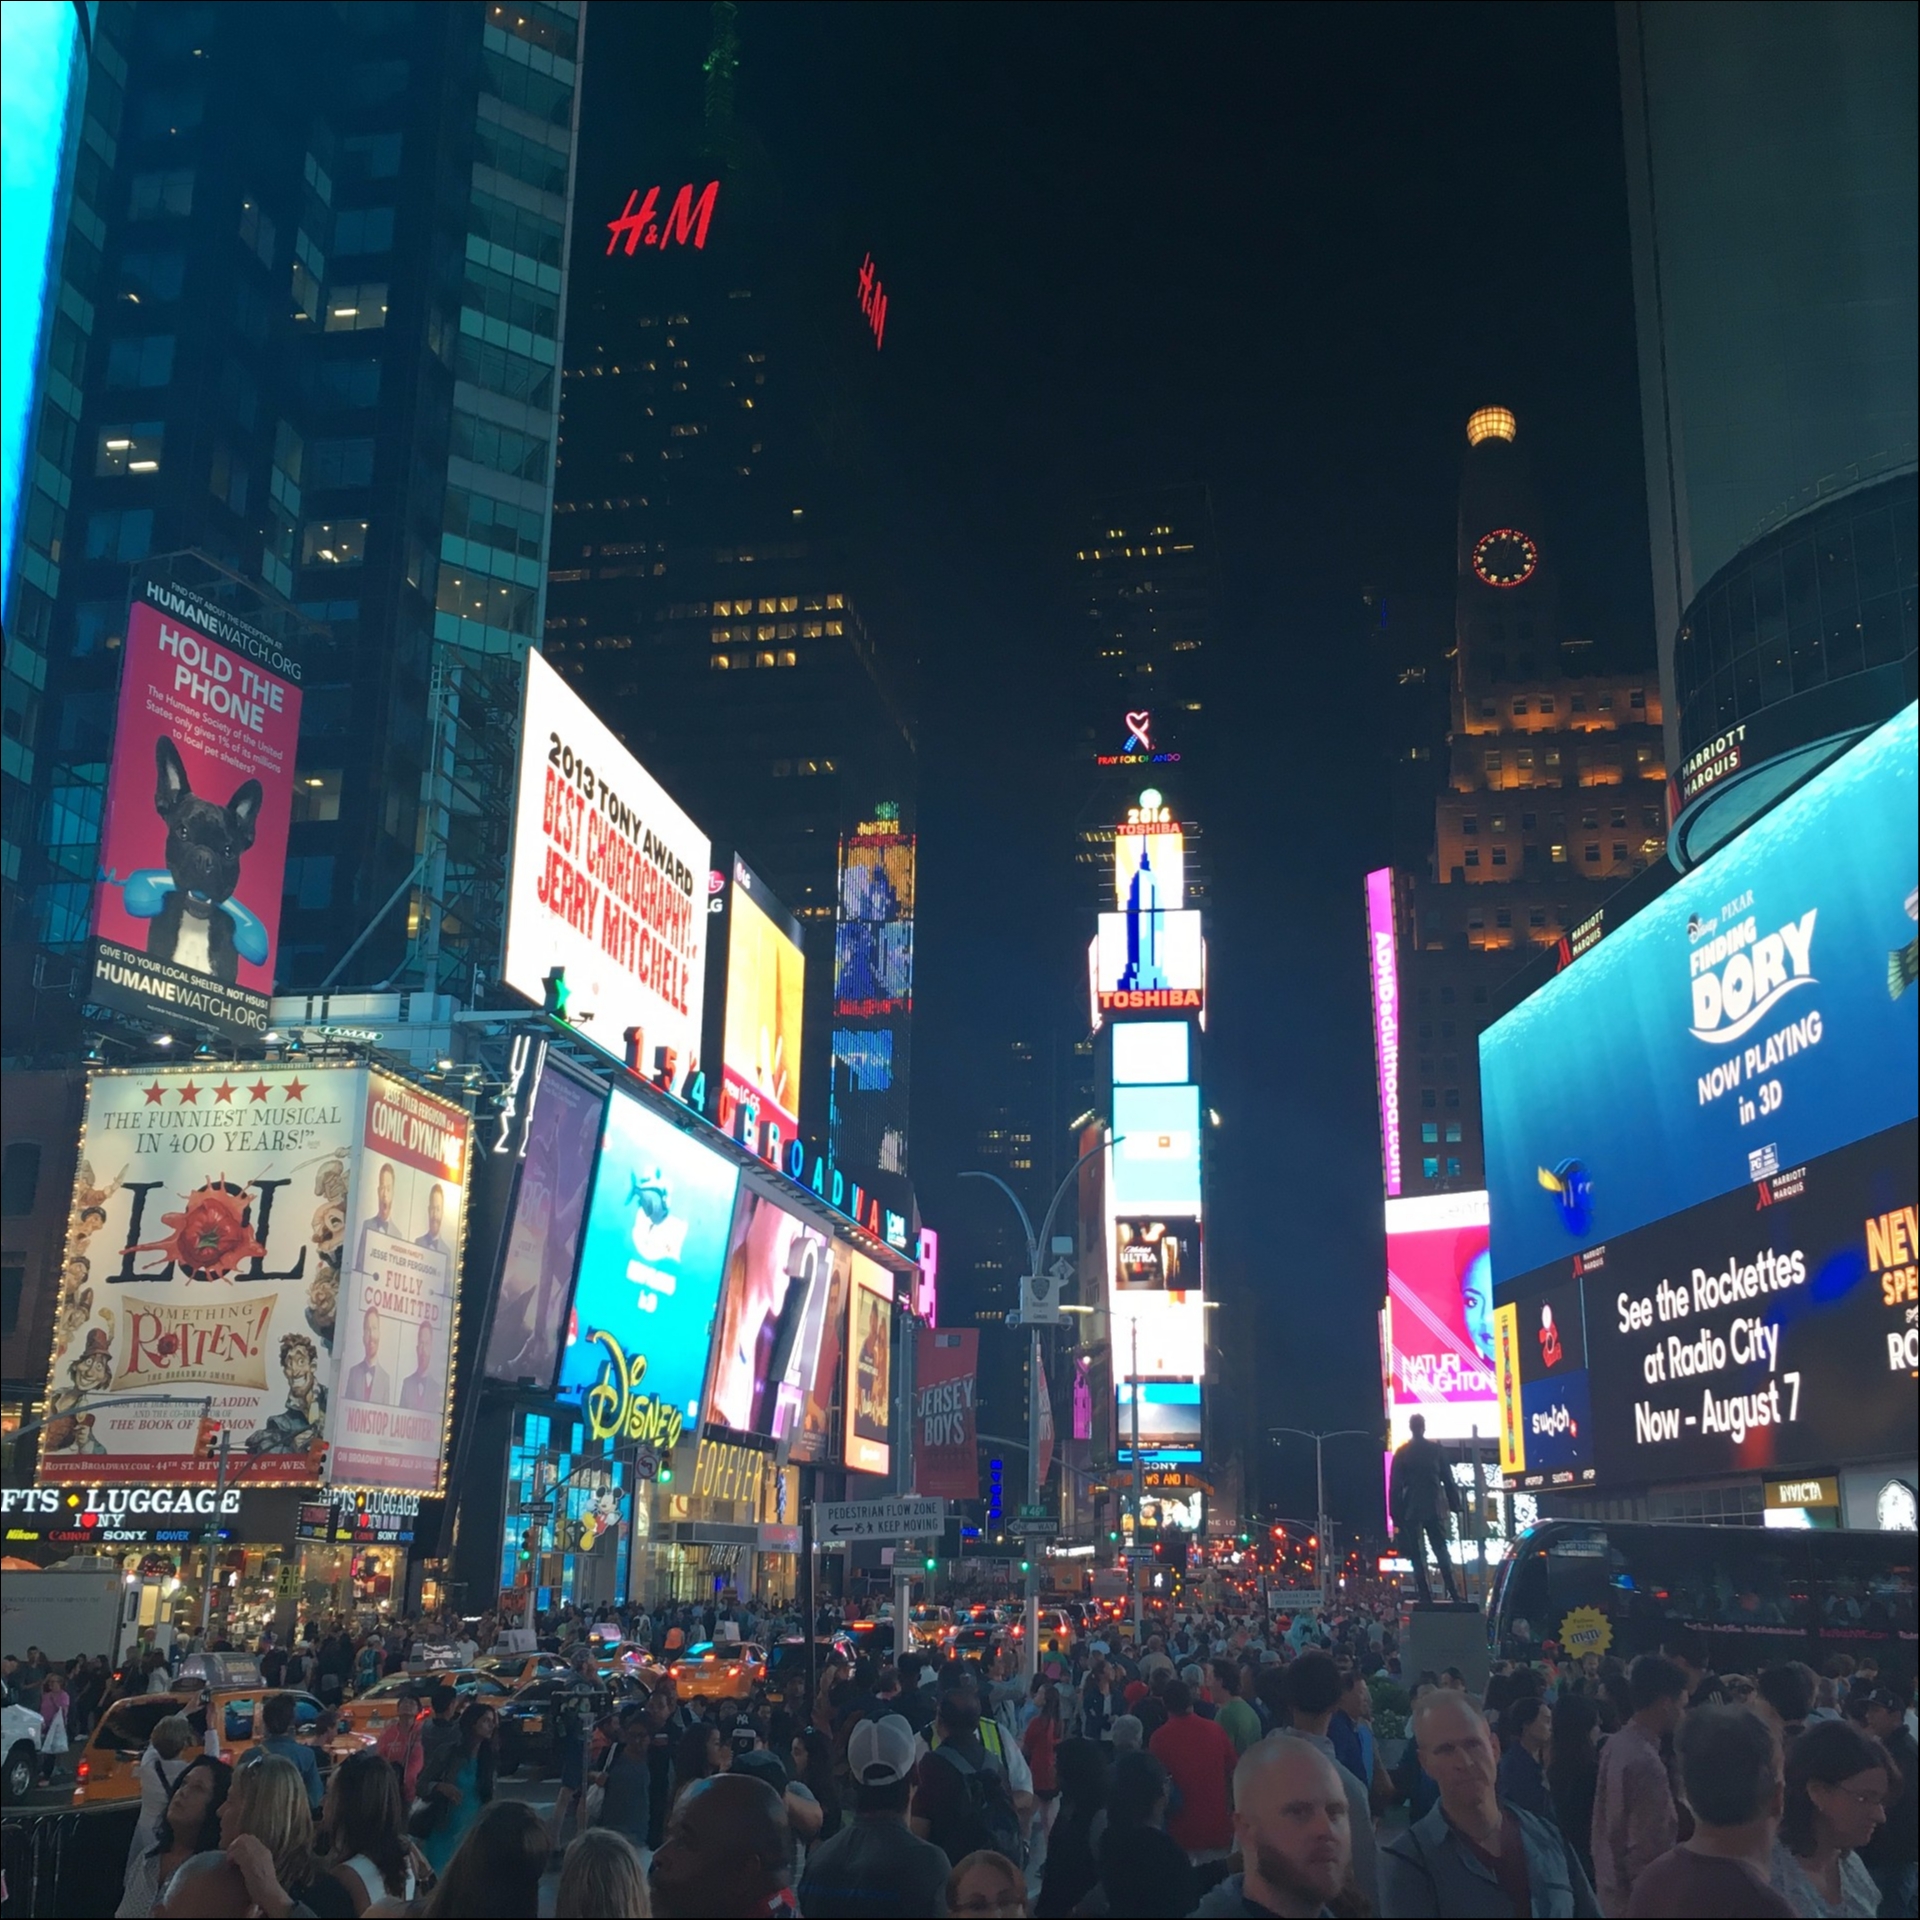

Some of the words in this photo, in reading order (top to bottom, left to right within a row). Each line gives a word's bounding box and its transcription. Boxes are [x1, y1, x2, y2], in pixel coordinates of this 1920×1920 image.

[607, 180, 719, 256] H&M
[147, 581, 302, 680] HUMANEWATCH.ORG
[159, 624, 232, 683] HOLD
[239, 666, 284, 713] THE
[174, 664, 265, 733] PHONE
[146, 699, 173, 720] States
[174, 715, 192, 732] only
[194, 724, 216, 743] gives
[252, 752, 281, 773] millions
[148, 684, 164, 701] The
[165, 693, 200, 719] Humane
[202, 712, 232, 736] Society
[233, 729, 242, 739] of
[243, 733, 256, 747] the
[257, 740, 283, 760] United
[172, 728, 182, 740] to
[183, 732, 203, 750] local
[1682, 725, 1746, 780] MARRIOTT
[1098, 757, 1118, 765] PRAY
[1120, 755, 1136, 764] FOR
[1684, 751, 1739, 800] MARQUIS
[542, 764, 585, 860] BEST
[549, 731, 595, 800] 2013
[598, 778, 642, 845] TONY
[642, 828, 693, 897] AWARD
[1128, 807, 1170, 824] 2016
[1118, 823, 1181, 835] TOSHIBA
[537, 843, 600, 940] JERRY
[1721, 889, 1754, 923] PIXAR
[1572, 909, 1604, 942] MARRIOTT
[1572, 928, 1601, 956] MARQUIS
[1690, 916, 1757, 978] FINDING
[99, 944, 121, 960] GIVE
[123, 952, 135, 964] TO
[137, 956, 161, 973] YOUR
[162, 965, 189, 984] LOCAL
[226, 988, 244, 1002] NOT
[245, 994, 268, 1010] HSUS!
[1691, 907, 1818, 1029] DORY
[96, 959, 267, 1032] HUMANEWATCH.ORG
[1099, 990, 1200, 1008] TOSHIBA
[324, 1027, 376, 1040] LAMAR
[1697, 1055, 1741, 1106] NOW
[1744, 1010, 1823, 1080] PLAYING
[1739, 1096, 1756, 1126] in
[1758, 1079, 1782, 1115] 3D
[104, 1111, 143, 1130] THE
[147, 1109, 248, 1128] FUNNIEST
[252, 1106, 342, 1126] MUSICAL
[372, 1101, 406, 1147] COMIC
[135, 1132, 163, 1154] IN
[170, 1132, 214, 1152] 400
[1771, 1167, 1807, 1187] MARRIOTT
[1773, 1181, 1805, 1200] MARQUIS
[370, 1248, 388, 1262] JESSE
[388, 1253, 406, 1267] TYLER
[407, 1260, 438, 1276] FERGUSON
[1120, 1253, 1157, 1262] ULTRA
[1582, 1245, 1606, 1262] MARRIOTT
[1583, 1256, 1605, 1271] MARQUIS
[385, 1270, 423, 1296] FULLY
[1617, 1292, 1653, 1334] See
[1656, 1278, 1689, 1322] the
[1691, 1247, 1806, 1313] Rockettes
[141, 1304, 254, 1320] SOMETHING
[364, 1286, 440, 1322] COMMITTED
[1644, 1342, 1666, 1384] at
[1668, 1328, 1726, 1380] Radio
[1730, 1316, 1779, 1373] City
[917, 1378, 975, 1418] JERSEY
[1634, 1400, 1680, 1444] Now
[1702, 1380, 1781, 1444] August
[1782, 1371, 1801, 1422] 7
[109, 1420, 135, 1430] THE
[138, 1420, 175, 1430] BOOK
[177, 1419, 195, 1430] OF
[153, 1410, 167, 1418] THE
[1532, 1403, 1570, 1437] swatch
[924, 1412, 965, 1446] BOYS
[692, 1439, 764, 1502] FOREVER
[1163, 1474, 1181, 1485] AND
[0, 1488, 59, 1513] FTS
[84, 1488, 241, 1514] LUGGAGE
[364, 1491, 421, 1516] LUGGAGE
[1779, 1481, 1823, 1503] INVICTA
[828, 1506, 884, 1520] PEDESTRIAN
[887, 1504, 911, 1518] FLOW
[914, 1502, 938, 1515] ZONE
[5, 1529, 39, 1540] Nikon
[48, 1530, 92, 1542] Canon
[103, 1530, 147, 1541] SONY
[156, 1530, 191, 1541] BOWER
[377, 1531, 398, 1540] SONY
[878, 1520, 900, 1533] KEEP
[903, 1518, 938, 1532] MOVING
[1038, 1523, 1055, 1531] WAY
[279, 1566, 290, 1594] ATM
